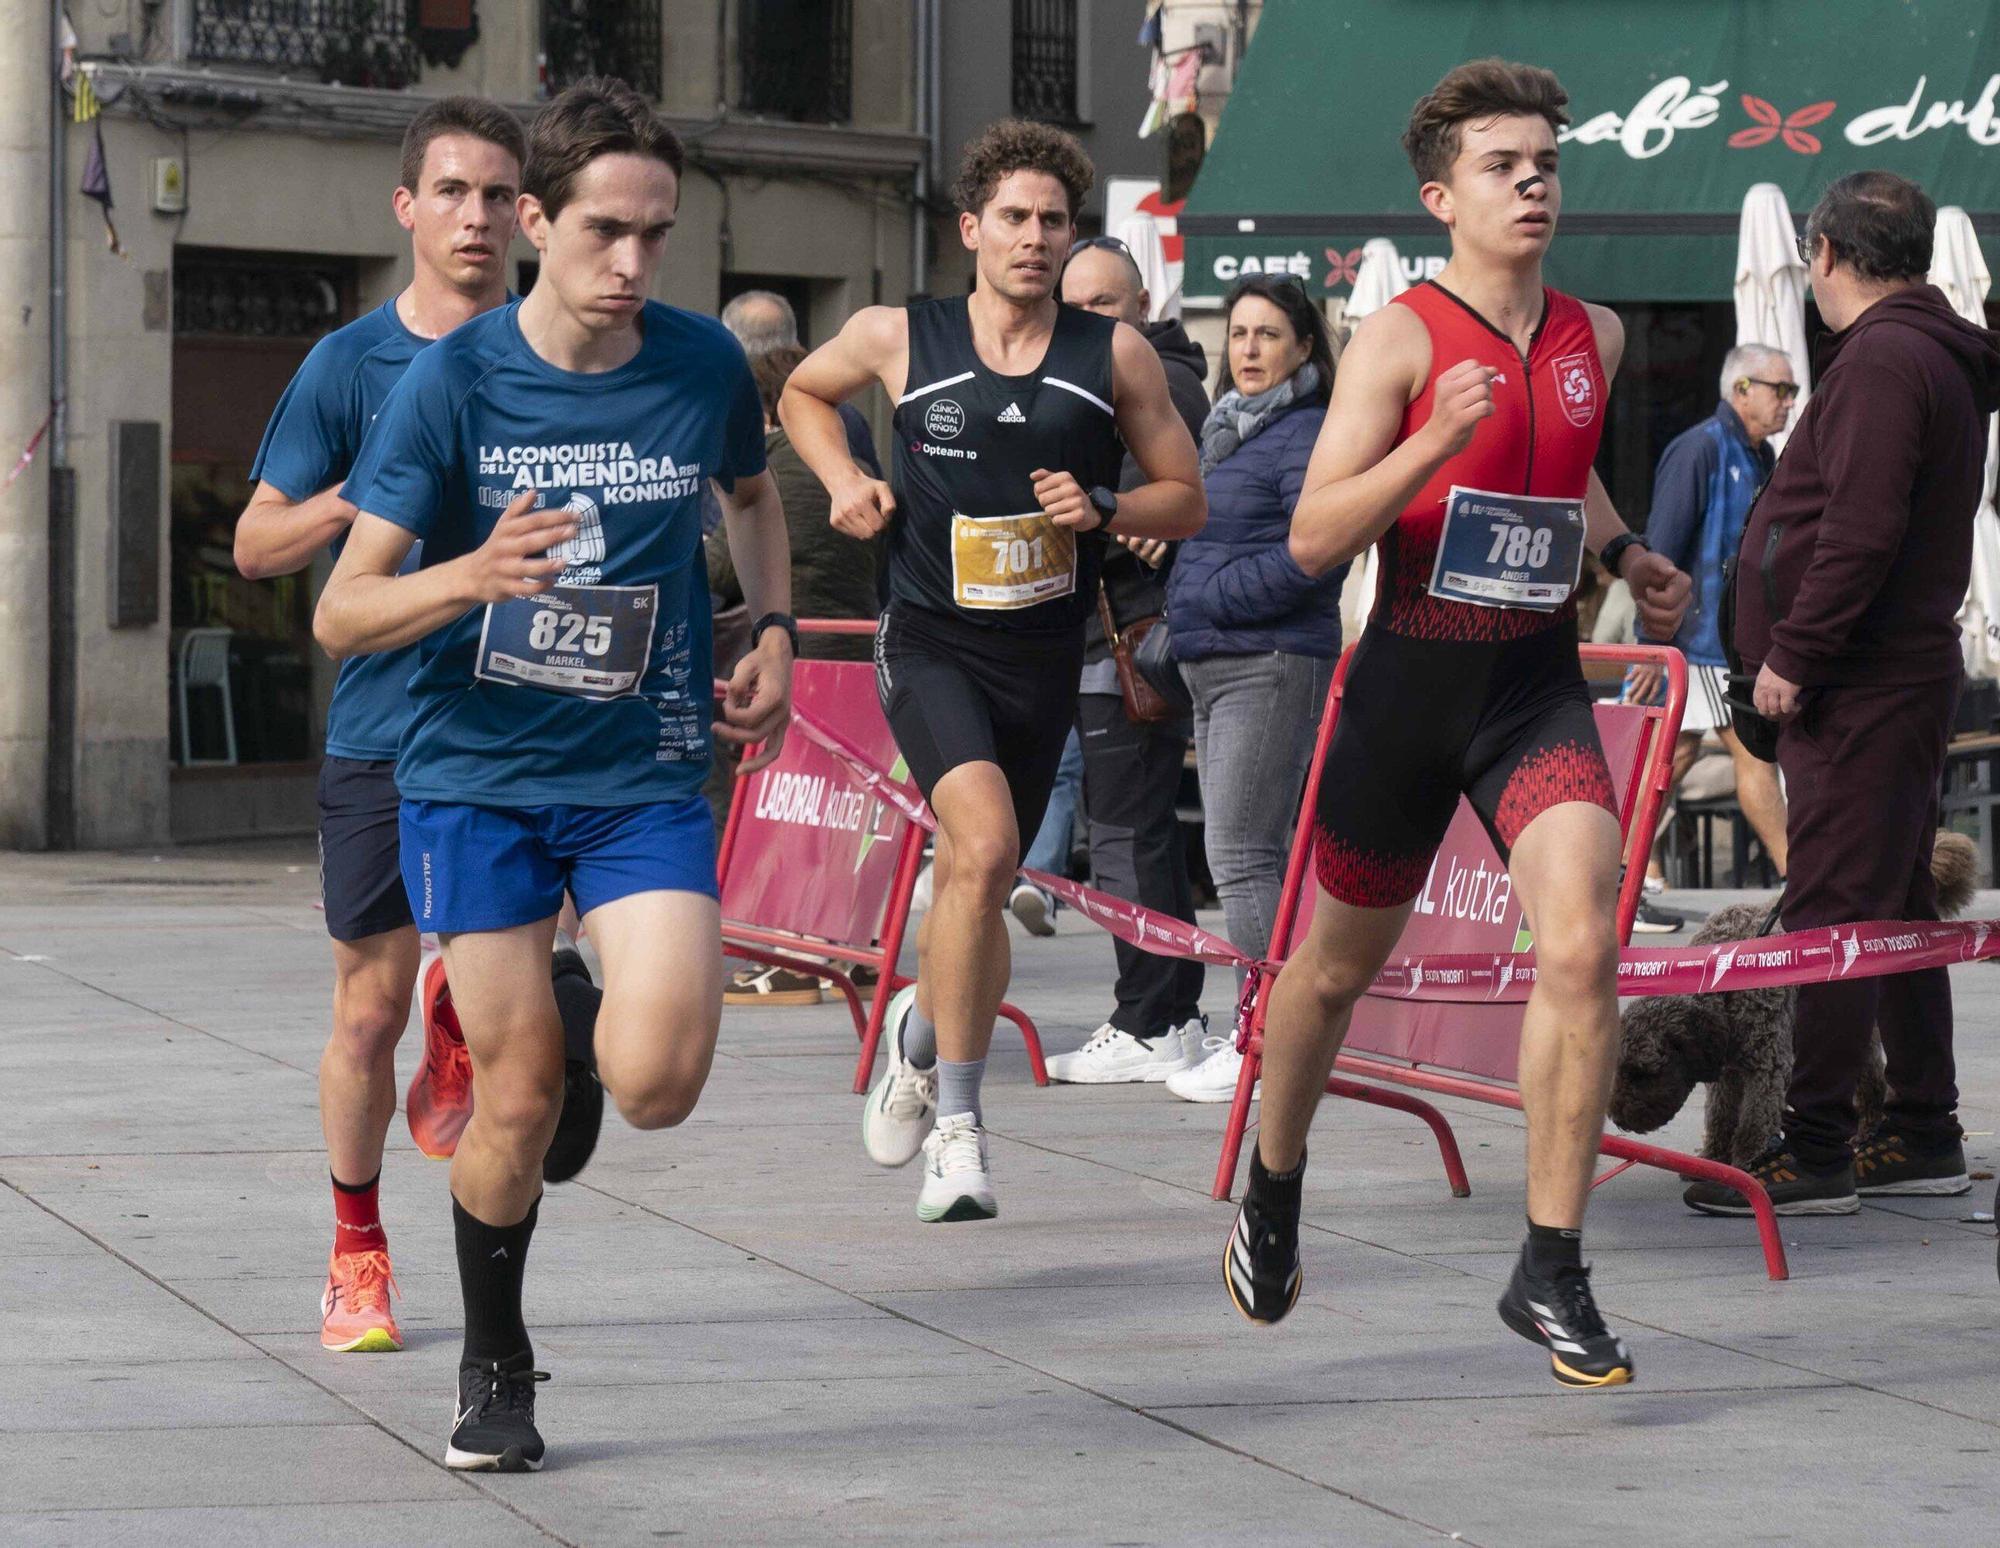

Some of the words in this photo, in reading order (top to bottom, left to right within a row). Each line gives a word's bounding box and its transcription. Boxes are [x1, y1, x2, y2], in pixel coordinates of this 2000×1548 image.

[1558, 75, 1729, 159] afé
[1213, 251, 1311, 280] CAFÉ
[931, 402, 960, 415] CLÍNICA
[930, 414, 958, 424] DENTAL
[997, 414, 1026, 423] adidas
[929, 421, 958, 434] PEÑOTA
[479, 446, 505, 463] LA
[507, 441, 635, 465] CONQUISTA
[923, 443, 964, 458] Opteam
[966, 450, 977, 460] 10
[480, 463, 496, 474] DE
[499, 463, 515, 475] LA
[512, 455, 678, 489] ALMENDRA
[678, 463, 700, 478] REN
[603, 476, 699, 505] KONKISTA
[1486, 523, 1552, 568] 788
[992, 537, 1043, 574] 701
[561, 567, 602, 576] VITORIA
[1500, 570, 1530, 582] ANDER
[632, 597, 648, 609] 5K
[529, 609, 613, 656] 825
[545, 655, 586, 668] MARKEL
[755, 770, 826, 826] LABORAL
[822, 781, 865, 831] kutxa
[423, 852, 432, 919] SALOMON
[1441, 856, 1512, 924] kutxa
[1863, 938, 1884, 952] kutxa
[1884, 933, 1922, 951] LABORAL
[1736, 952, 1757, 967] kutxa
[1758, 950, 1791, 967] LABORAL
[1441, 969, 1464, 984] LABORAL
[1618, 962, 1633, 976] kutx
[1634, 961, 1667, 976] LABORAL
